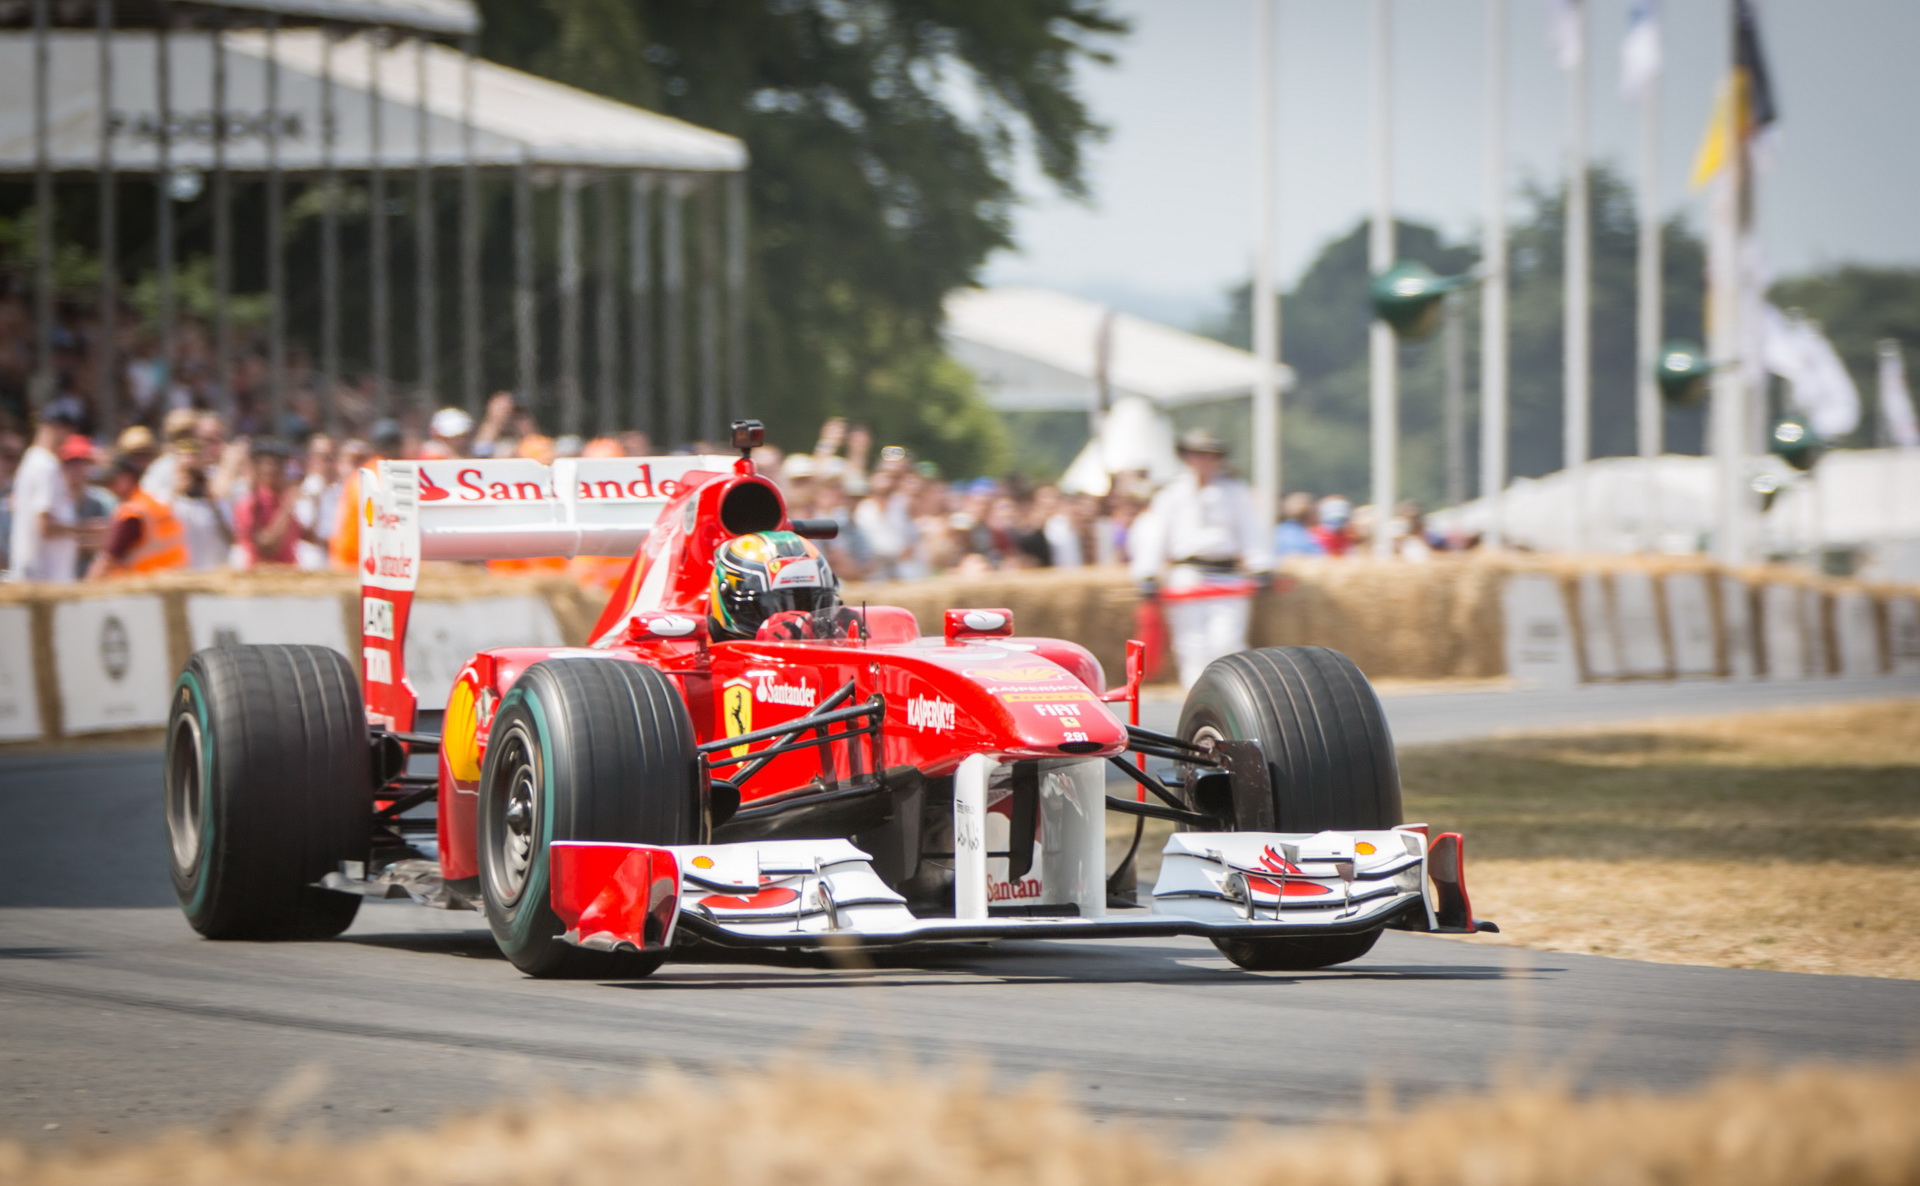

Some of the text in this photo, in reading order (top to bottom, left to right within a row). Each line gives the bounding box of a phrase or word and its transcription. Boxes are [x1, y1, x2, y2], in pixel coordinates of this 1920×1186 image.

[767, 675, 816, 707] Santander
[907, 692, 951, 735] KASPERSKY
[1034, 704, 1081, 716] FIAT
